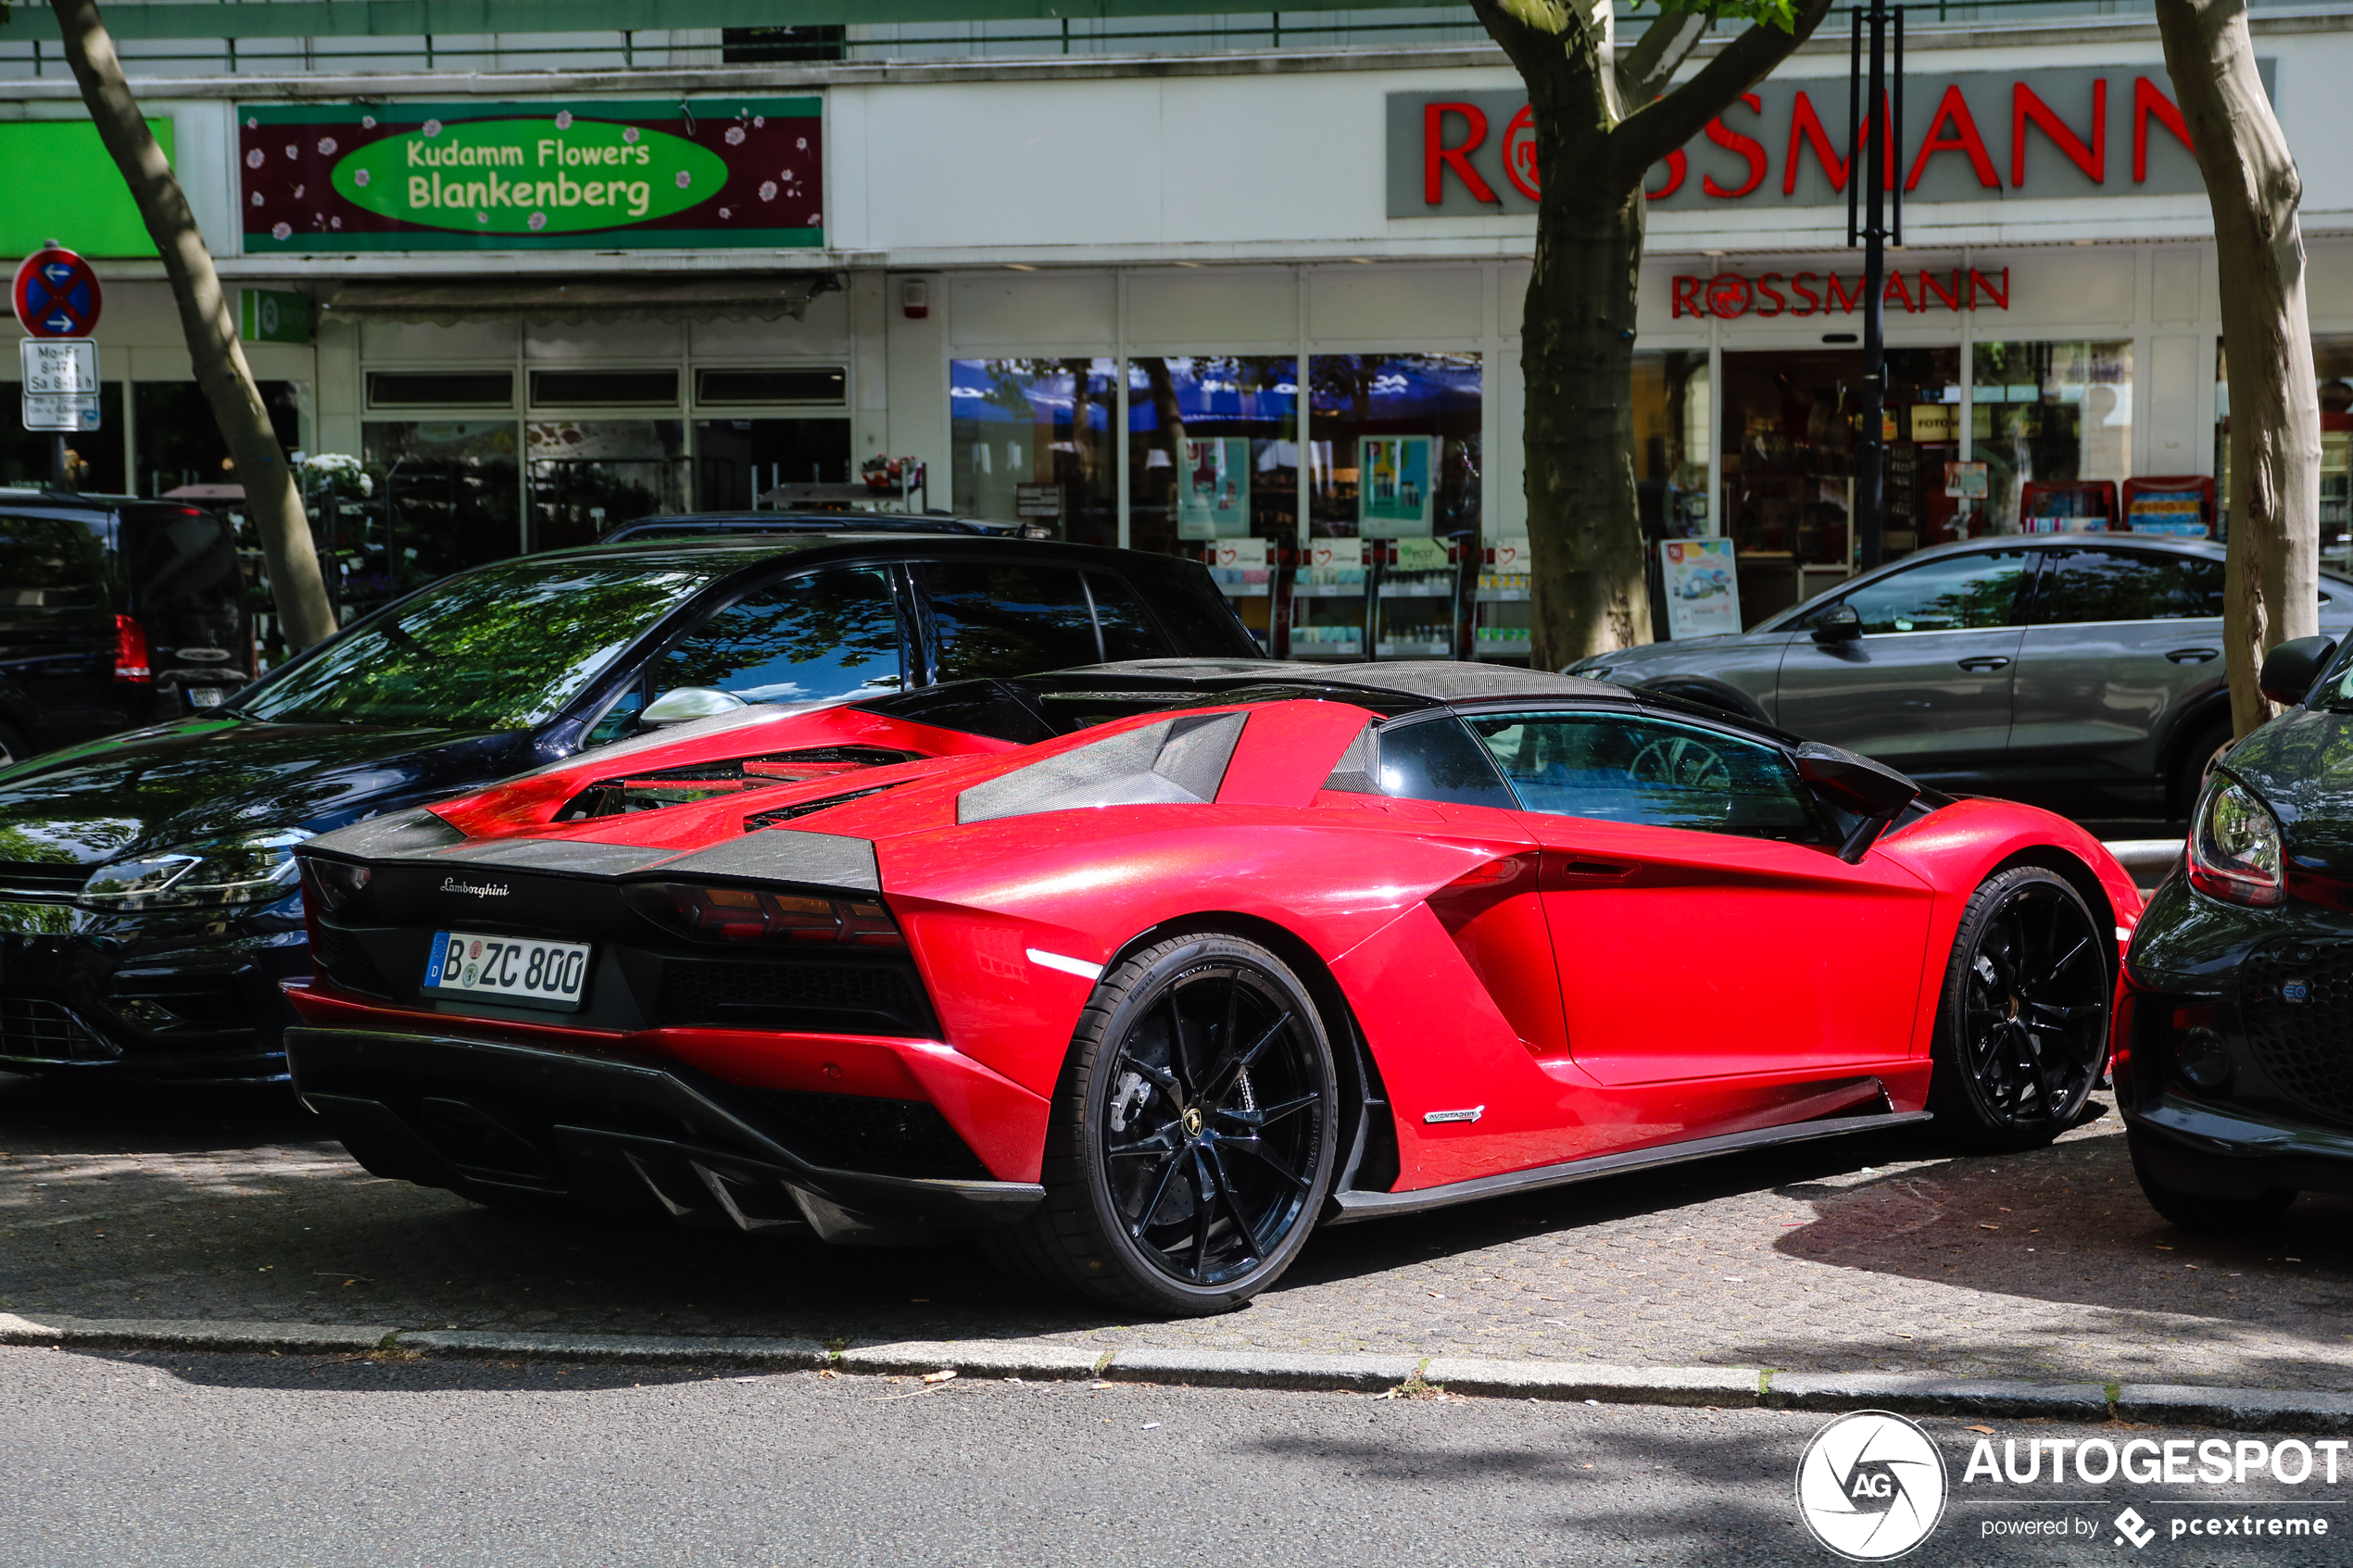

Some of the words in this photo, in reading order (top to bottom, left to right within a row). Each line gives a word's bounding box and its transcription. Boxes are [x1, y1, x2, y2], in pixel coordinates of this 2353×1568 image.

[408, 139, 523, 167] Kudamm
[537, 138, 649, 167] Flowers
[409, 171, 649, 217] Blankenberg
[440, 877, 510, 898] Lamborghini
[431, 965, 438, 977] D
[443, 939, 464, 981] B
[479, 943, 521, 987] ZC
[524, 947, 583, 994] 800
[2284, 985, 2306, 997] EQ
